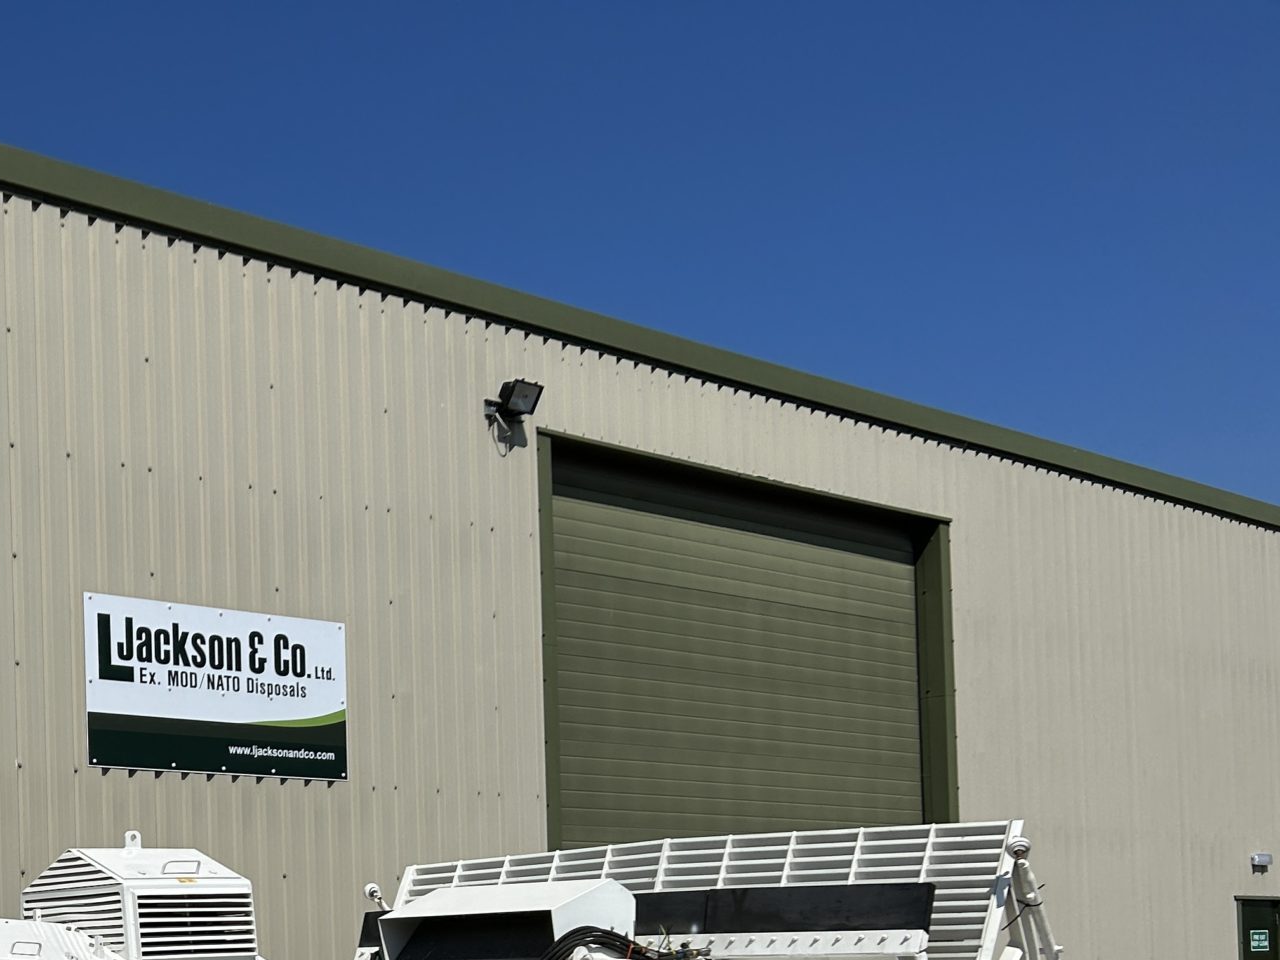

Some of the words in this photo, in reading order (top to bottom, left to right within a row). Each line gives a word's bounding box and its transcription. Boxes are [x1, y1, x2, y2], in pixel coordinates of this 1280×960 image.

[249, 631, 267, 675] &
[274, 633, 311, 678] Co.
[315, 666, 336, 681] Ltd.
[139, 667, 161, 685] Ex.
[168, 670, 240, 692] MOD/NATO
[247, 677, 307, 698] Disposals
[228, 745, 336, 761] www.ljacksonandco.com
